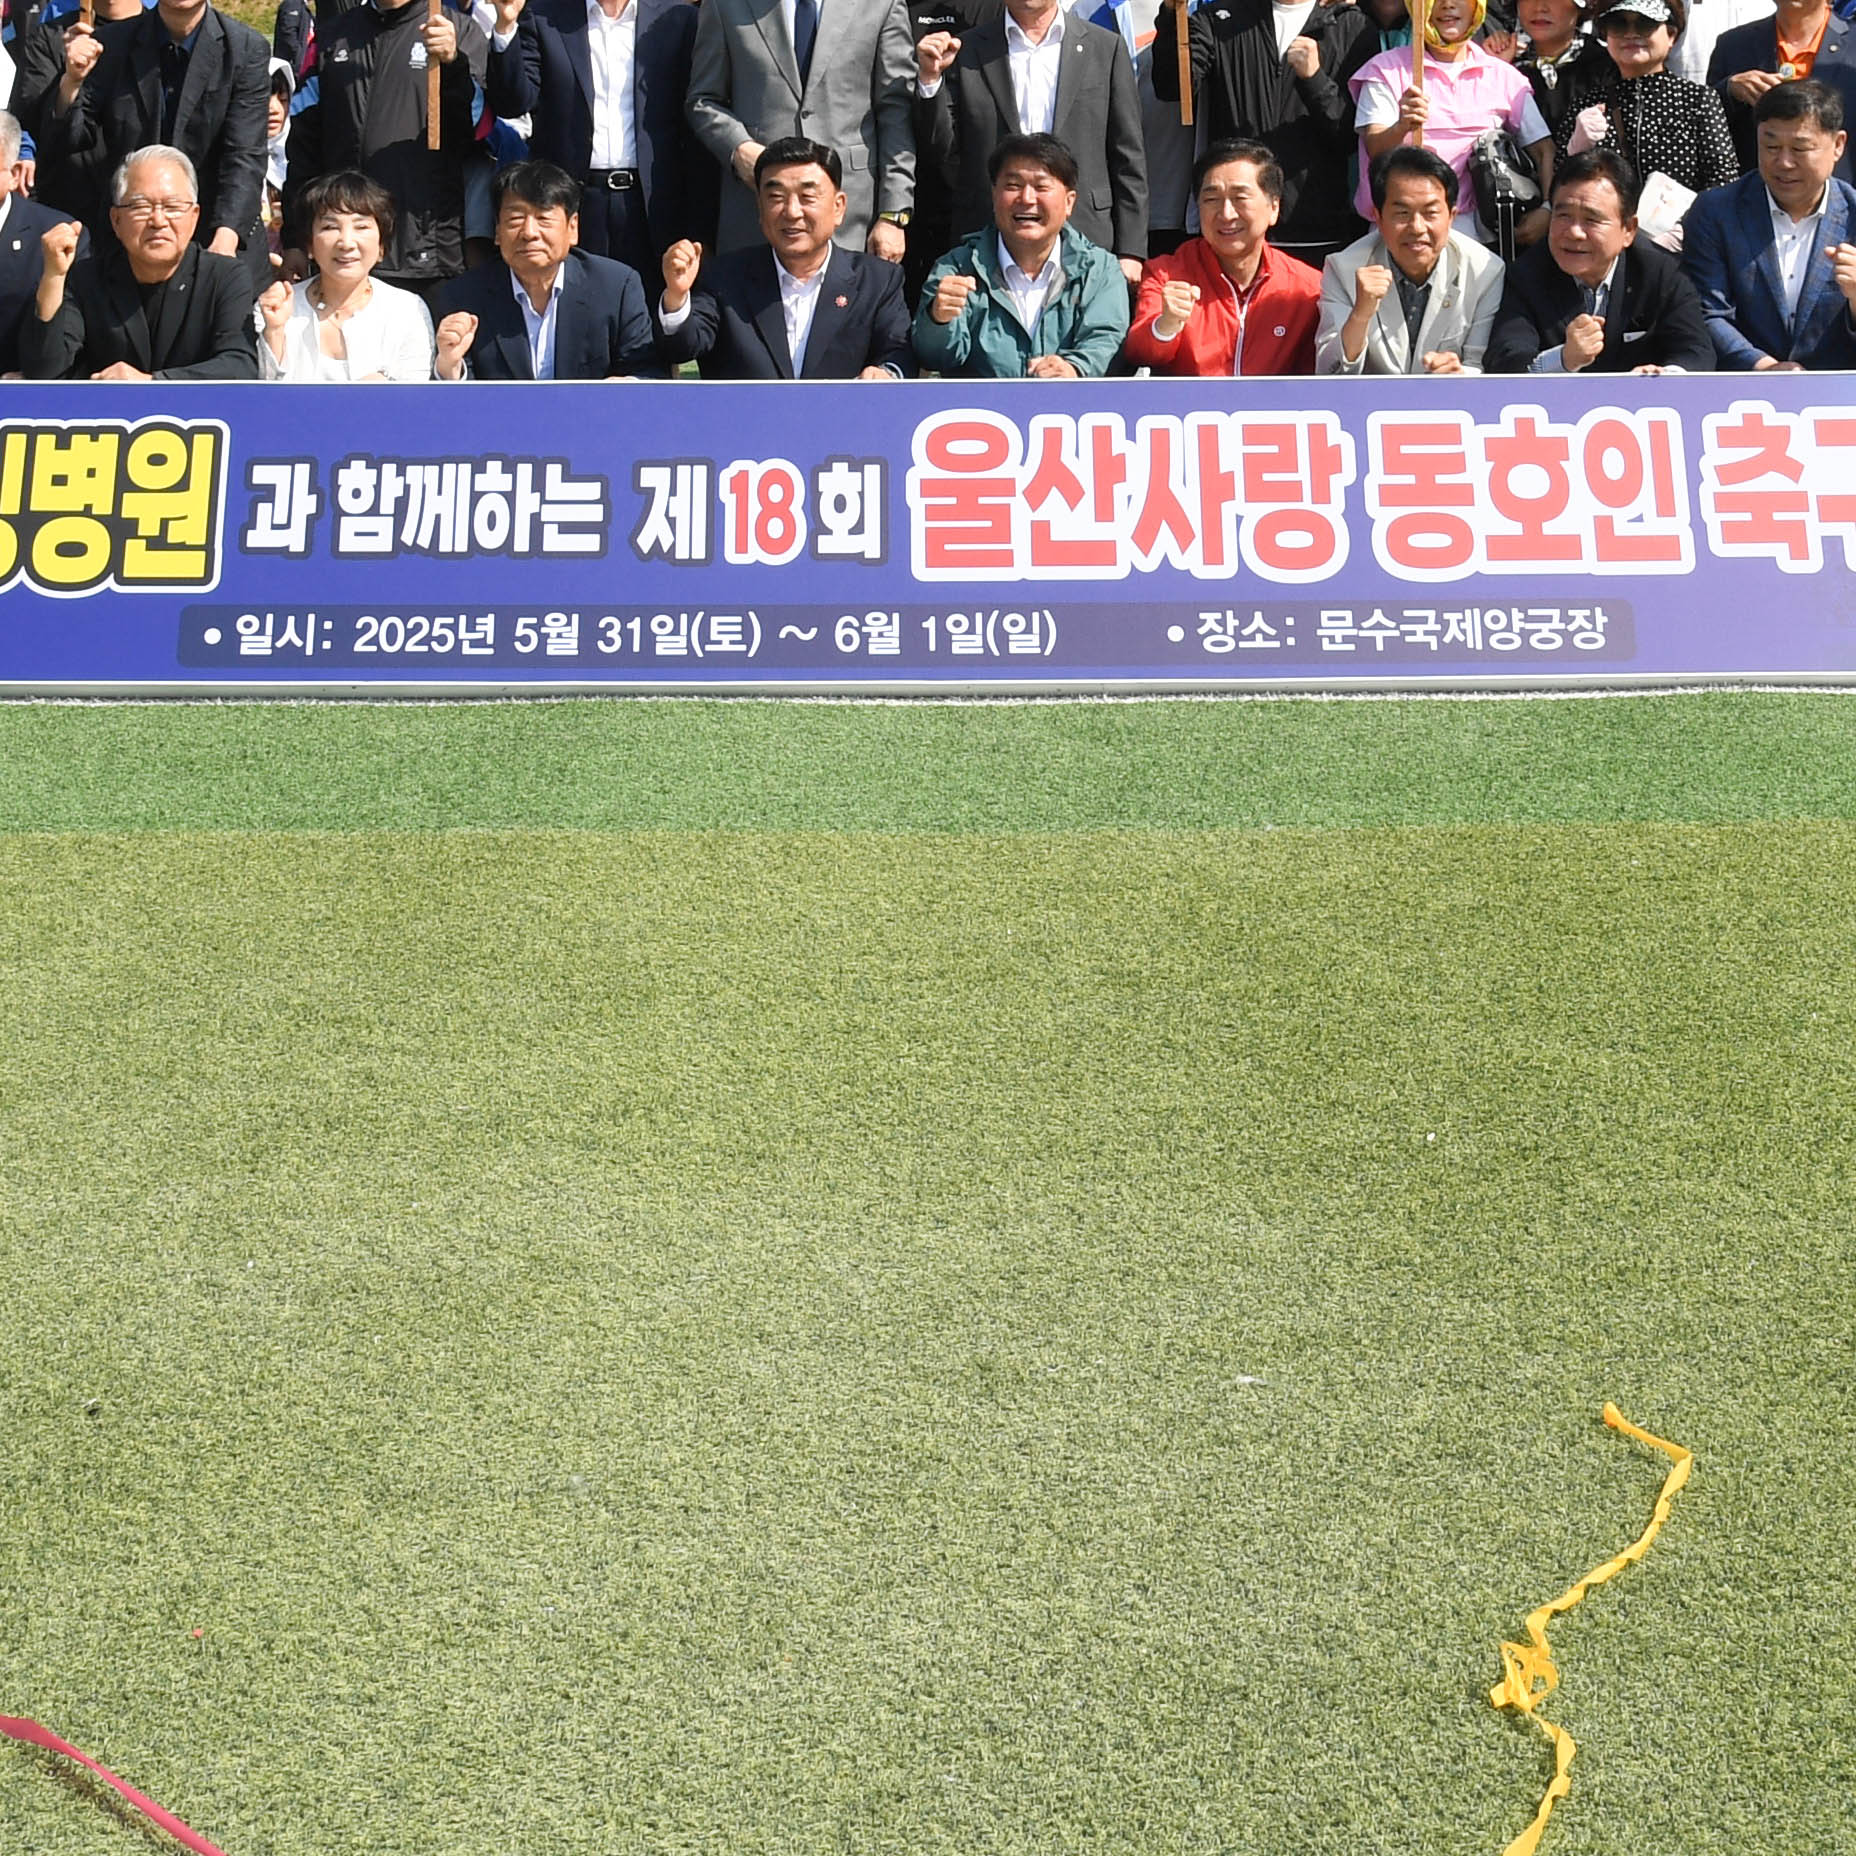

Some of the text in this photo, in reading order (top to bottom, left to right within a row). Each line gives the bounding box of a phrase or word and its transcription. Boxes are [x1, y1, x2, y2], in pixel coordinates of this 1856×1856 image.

[247, 464, 316, 552] 과
[338, 461, 603, 552] 함께하는
[637, 458, 880, 565] 제18회
[921, 422, 1341, 569] 울산사랑
[1378, 418, 1684, 568] 동호인
[236, 614, 332, 655] 일시:
[354, 614, 494, 654] 2025년
[514, 613, 578, 655] 5월
[598, 611, 761, 657] 31일(토)
[835, 612, 900, 654] 6월
[922, 610, 1056, 656] 1일(일)
[1197, 607, 1608, 653] 장소: 문수국제양궁장
